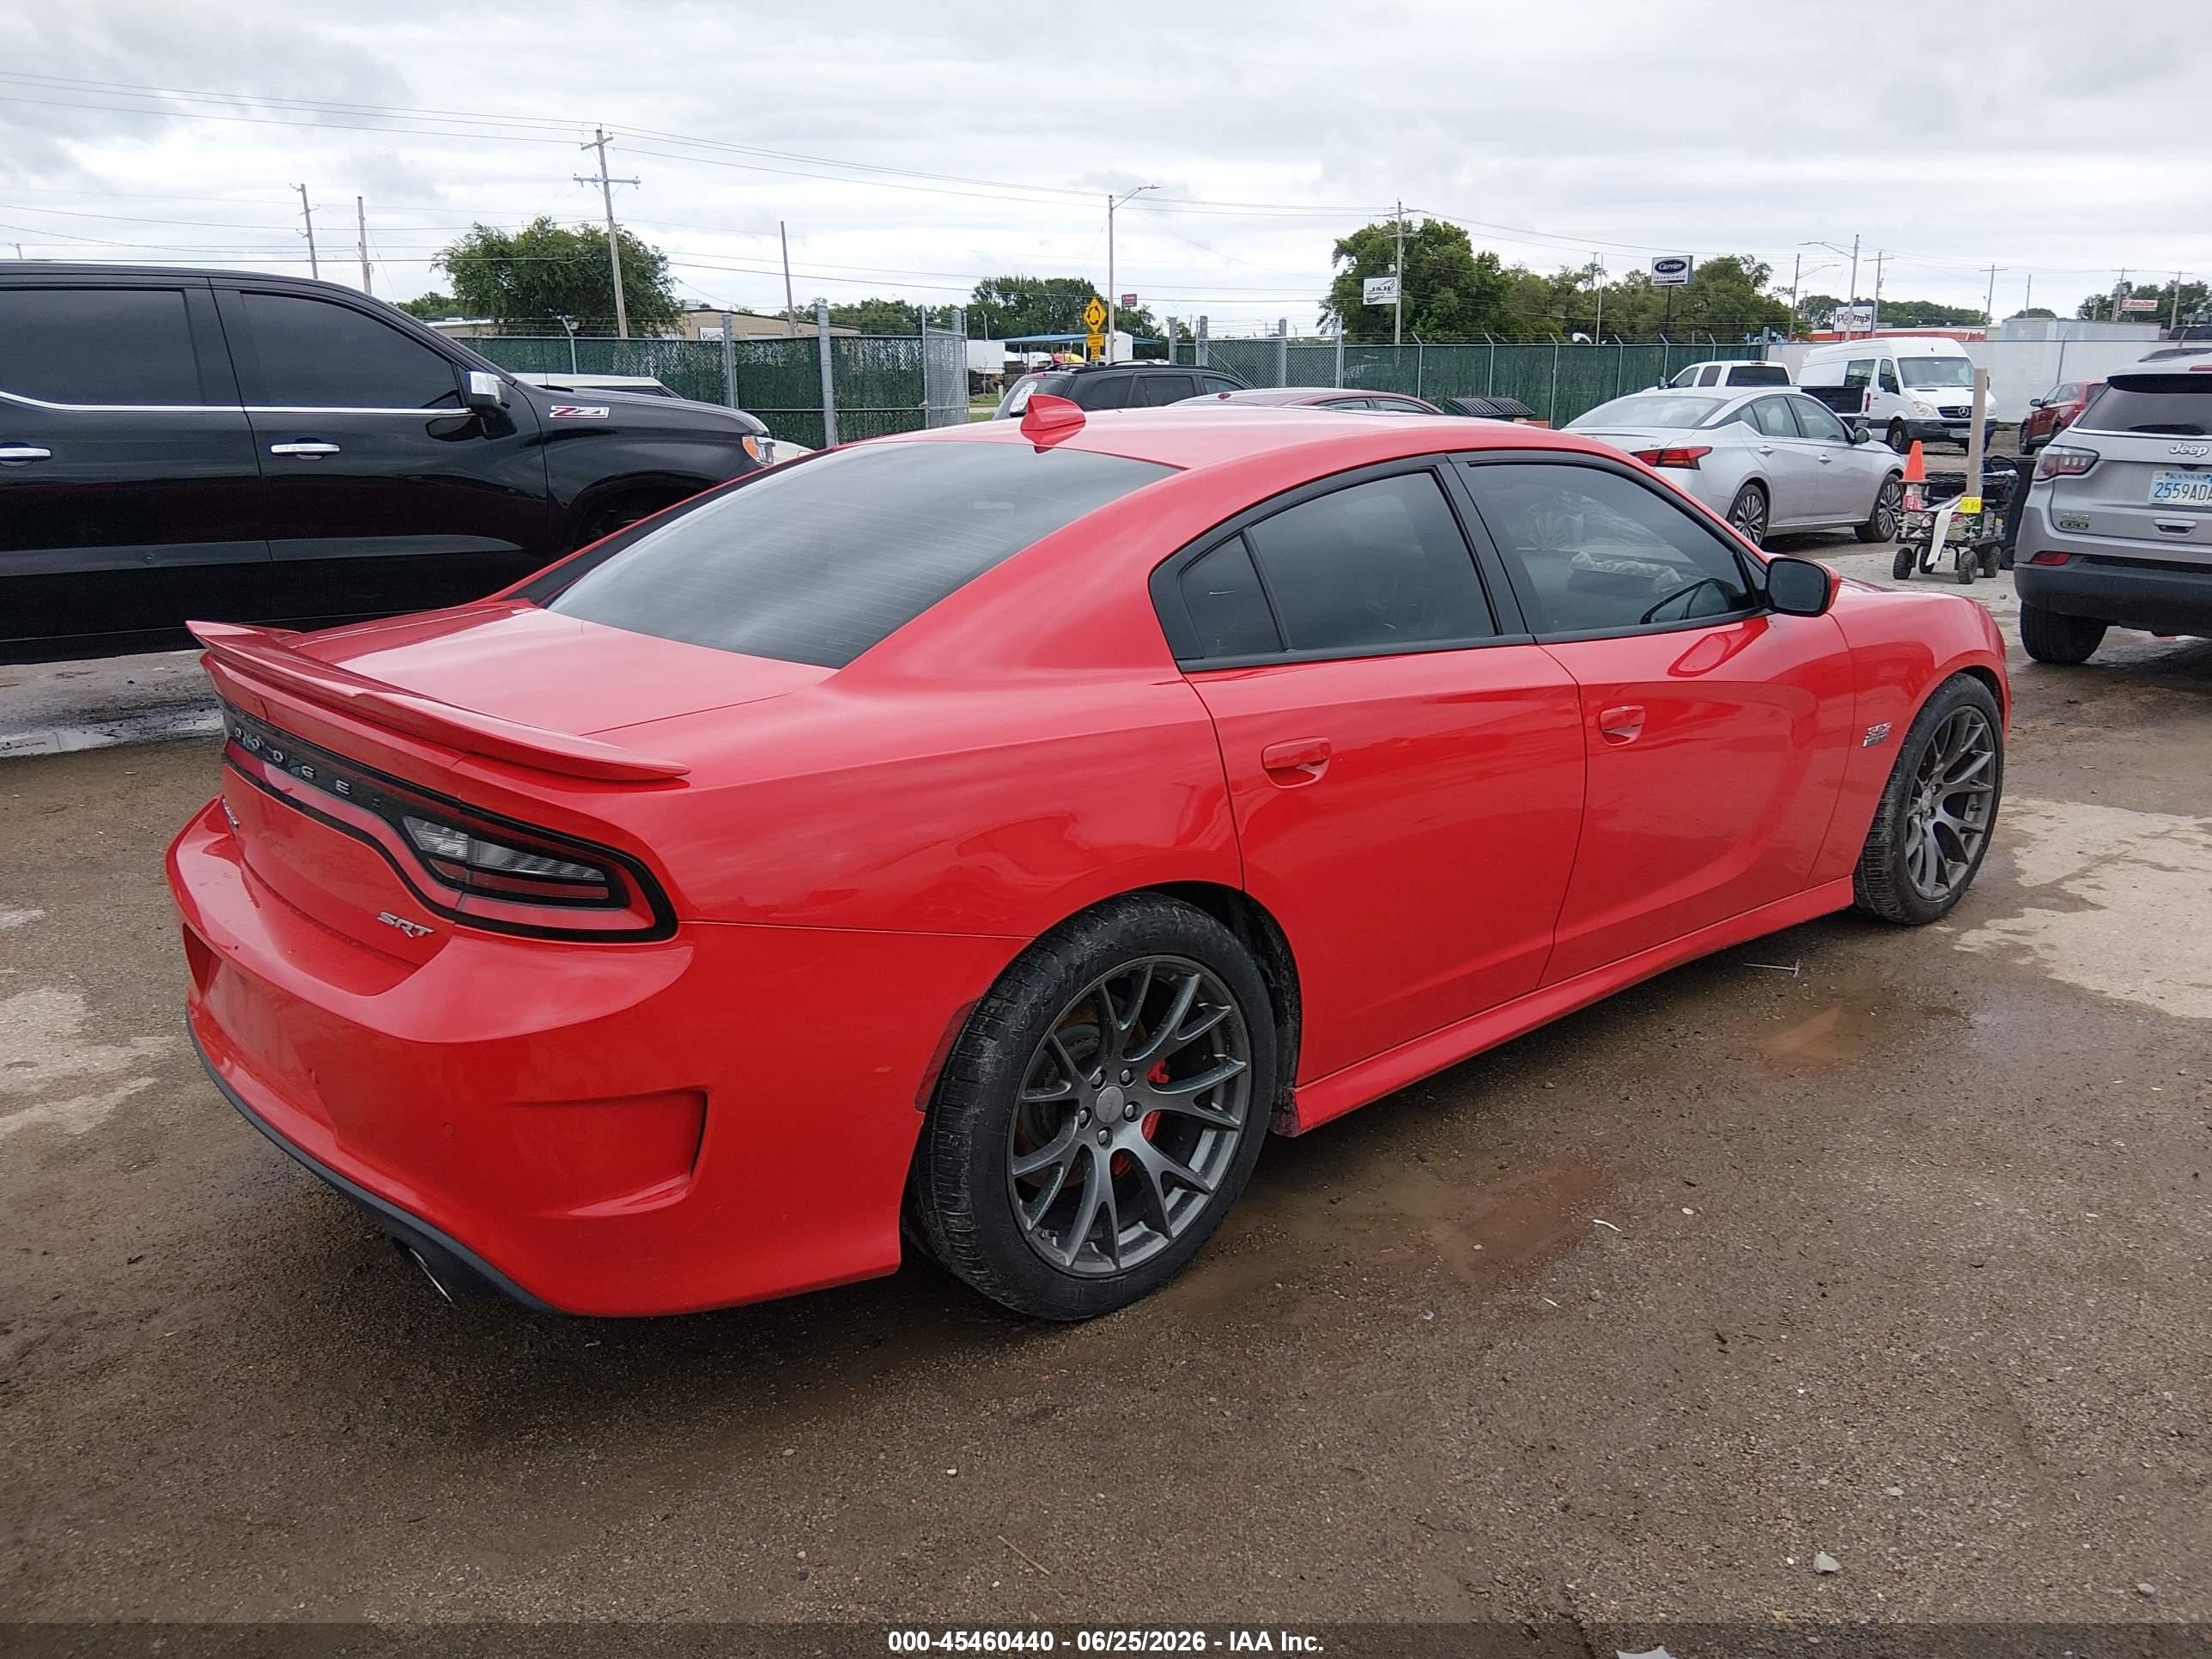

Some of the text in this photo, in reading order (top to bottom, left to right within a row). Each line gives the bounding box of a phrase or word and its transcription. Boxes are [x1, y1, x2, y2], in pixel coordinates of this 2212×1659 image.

[1658, 262, 1684, 270] Carrier
[549, 405, 611, 419] Z71
[2169, 443, 2209, 457] Jeep
[234, 726, 350, 795] DODGE
[377, 911, 435, 938] SRT
